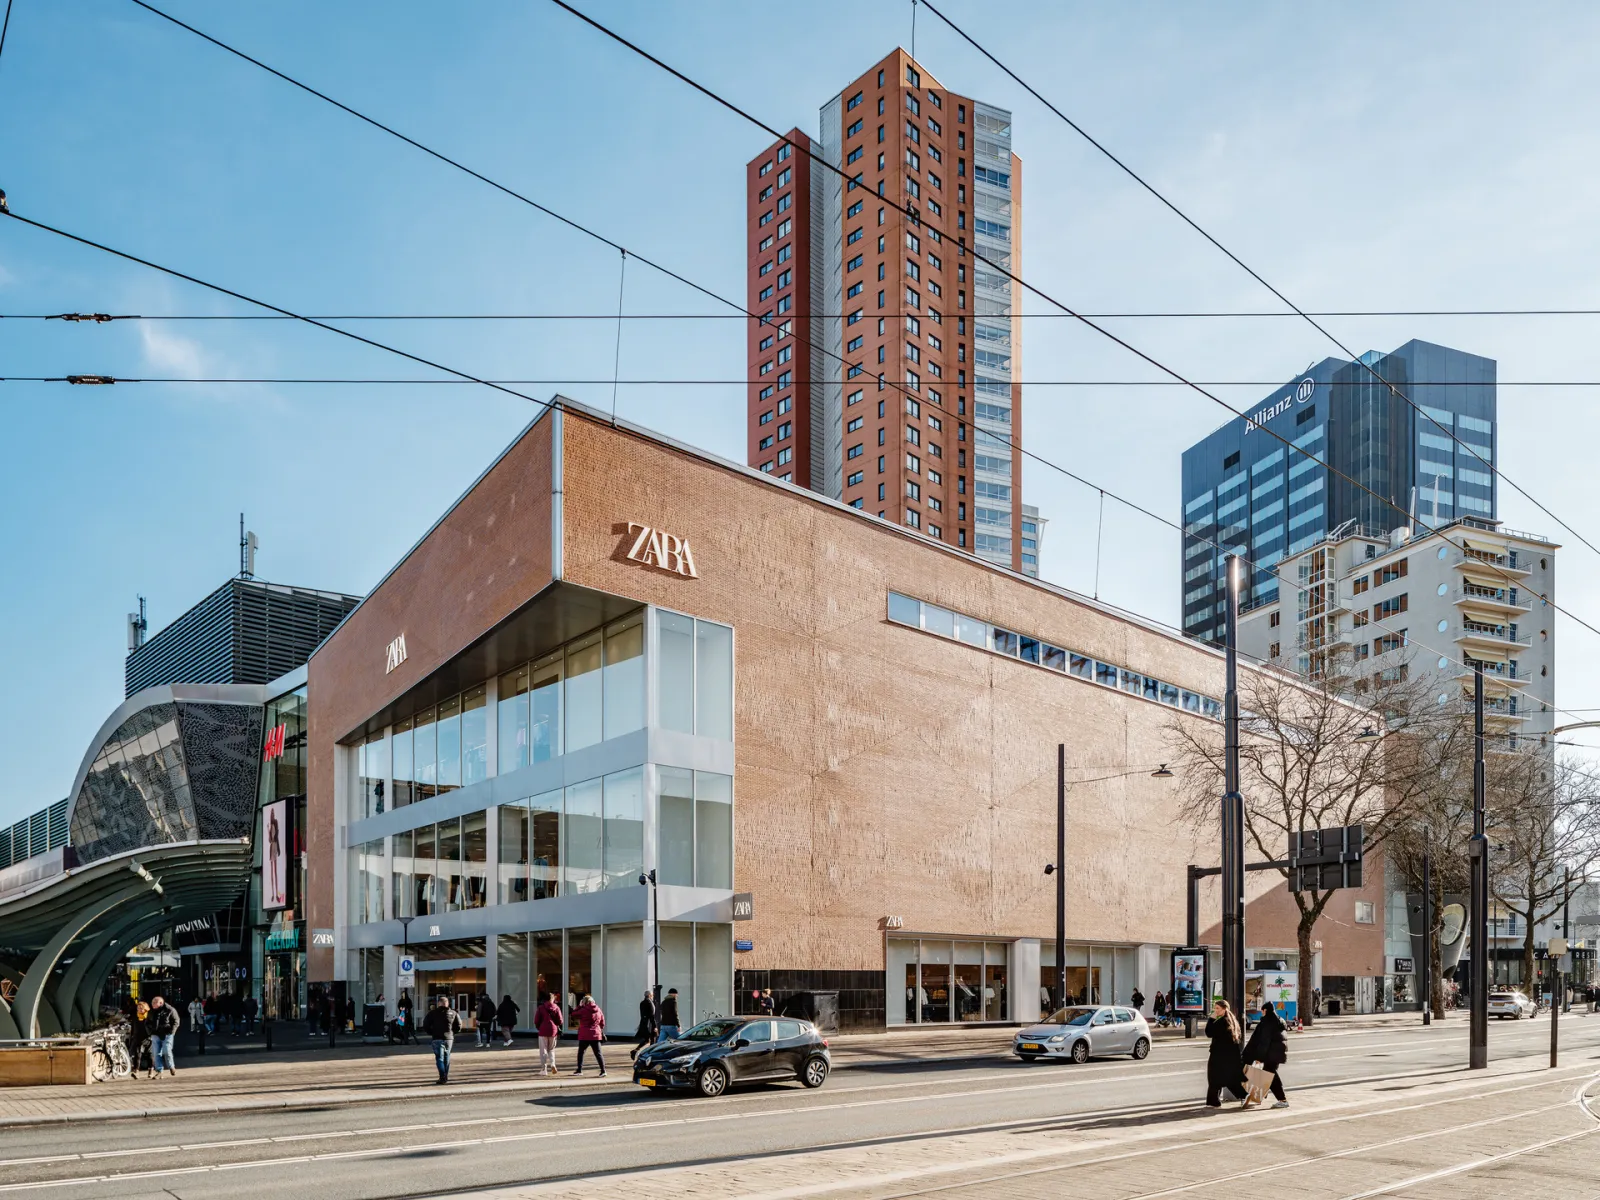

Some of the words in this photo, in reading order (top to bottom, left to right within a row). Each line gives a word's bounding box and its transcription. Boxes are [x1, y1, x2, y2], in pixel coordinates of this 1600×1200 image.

[1244, 395, 1292, 436] Allianz
[626, 521, 700, 579] ZARA
[385, 632, 408, 675] ZARA
[263, 722, 287, 763] H&M
[734, 901, 752, 916] ZARA
[886, 915, 904, 927] ZARA
[312, 933, 335, 945] ZARA
